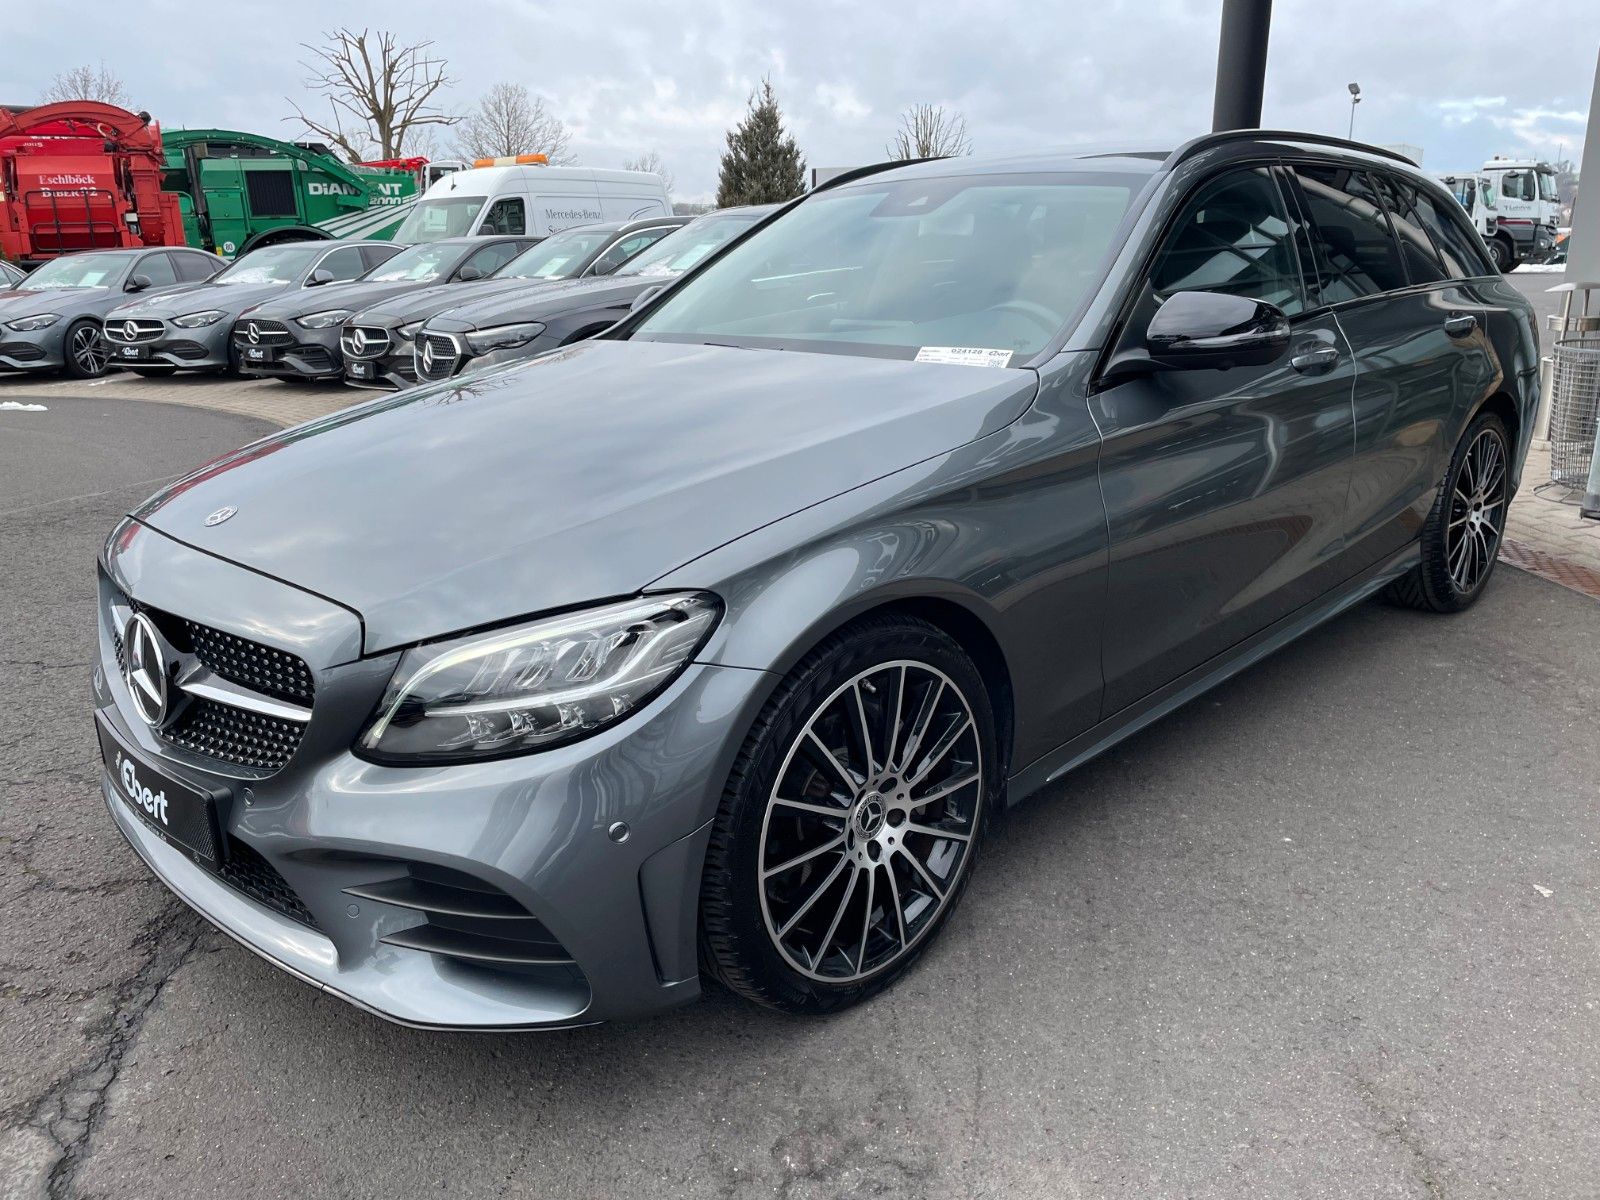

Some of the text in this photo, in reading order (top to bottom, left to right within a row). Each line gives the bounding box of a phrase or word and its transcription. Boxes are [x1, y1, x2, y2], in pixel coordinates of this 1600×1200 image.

[38, 174, 95, 185] Eschlböck
[545, 208, 602, 220] Mercedes-Benz
[120, 758, 169, 826] Ebert
